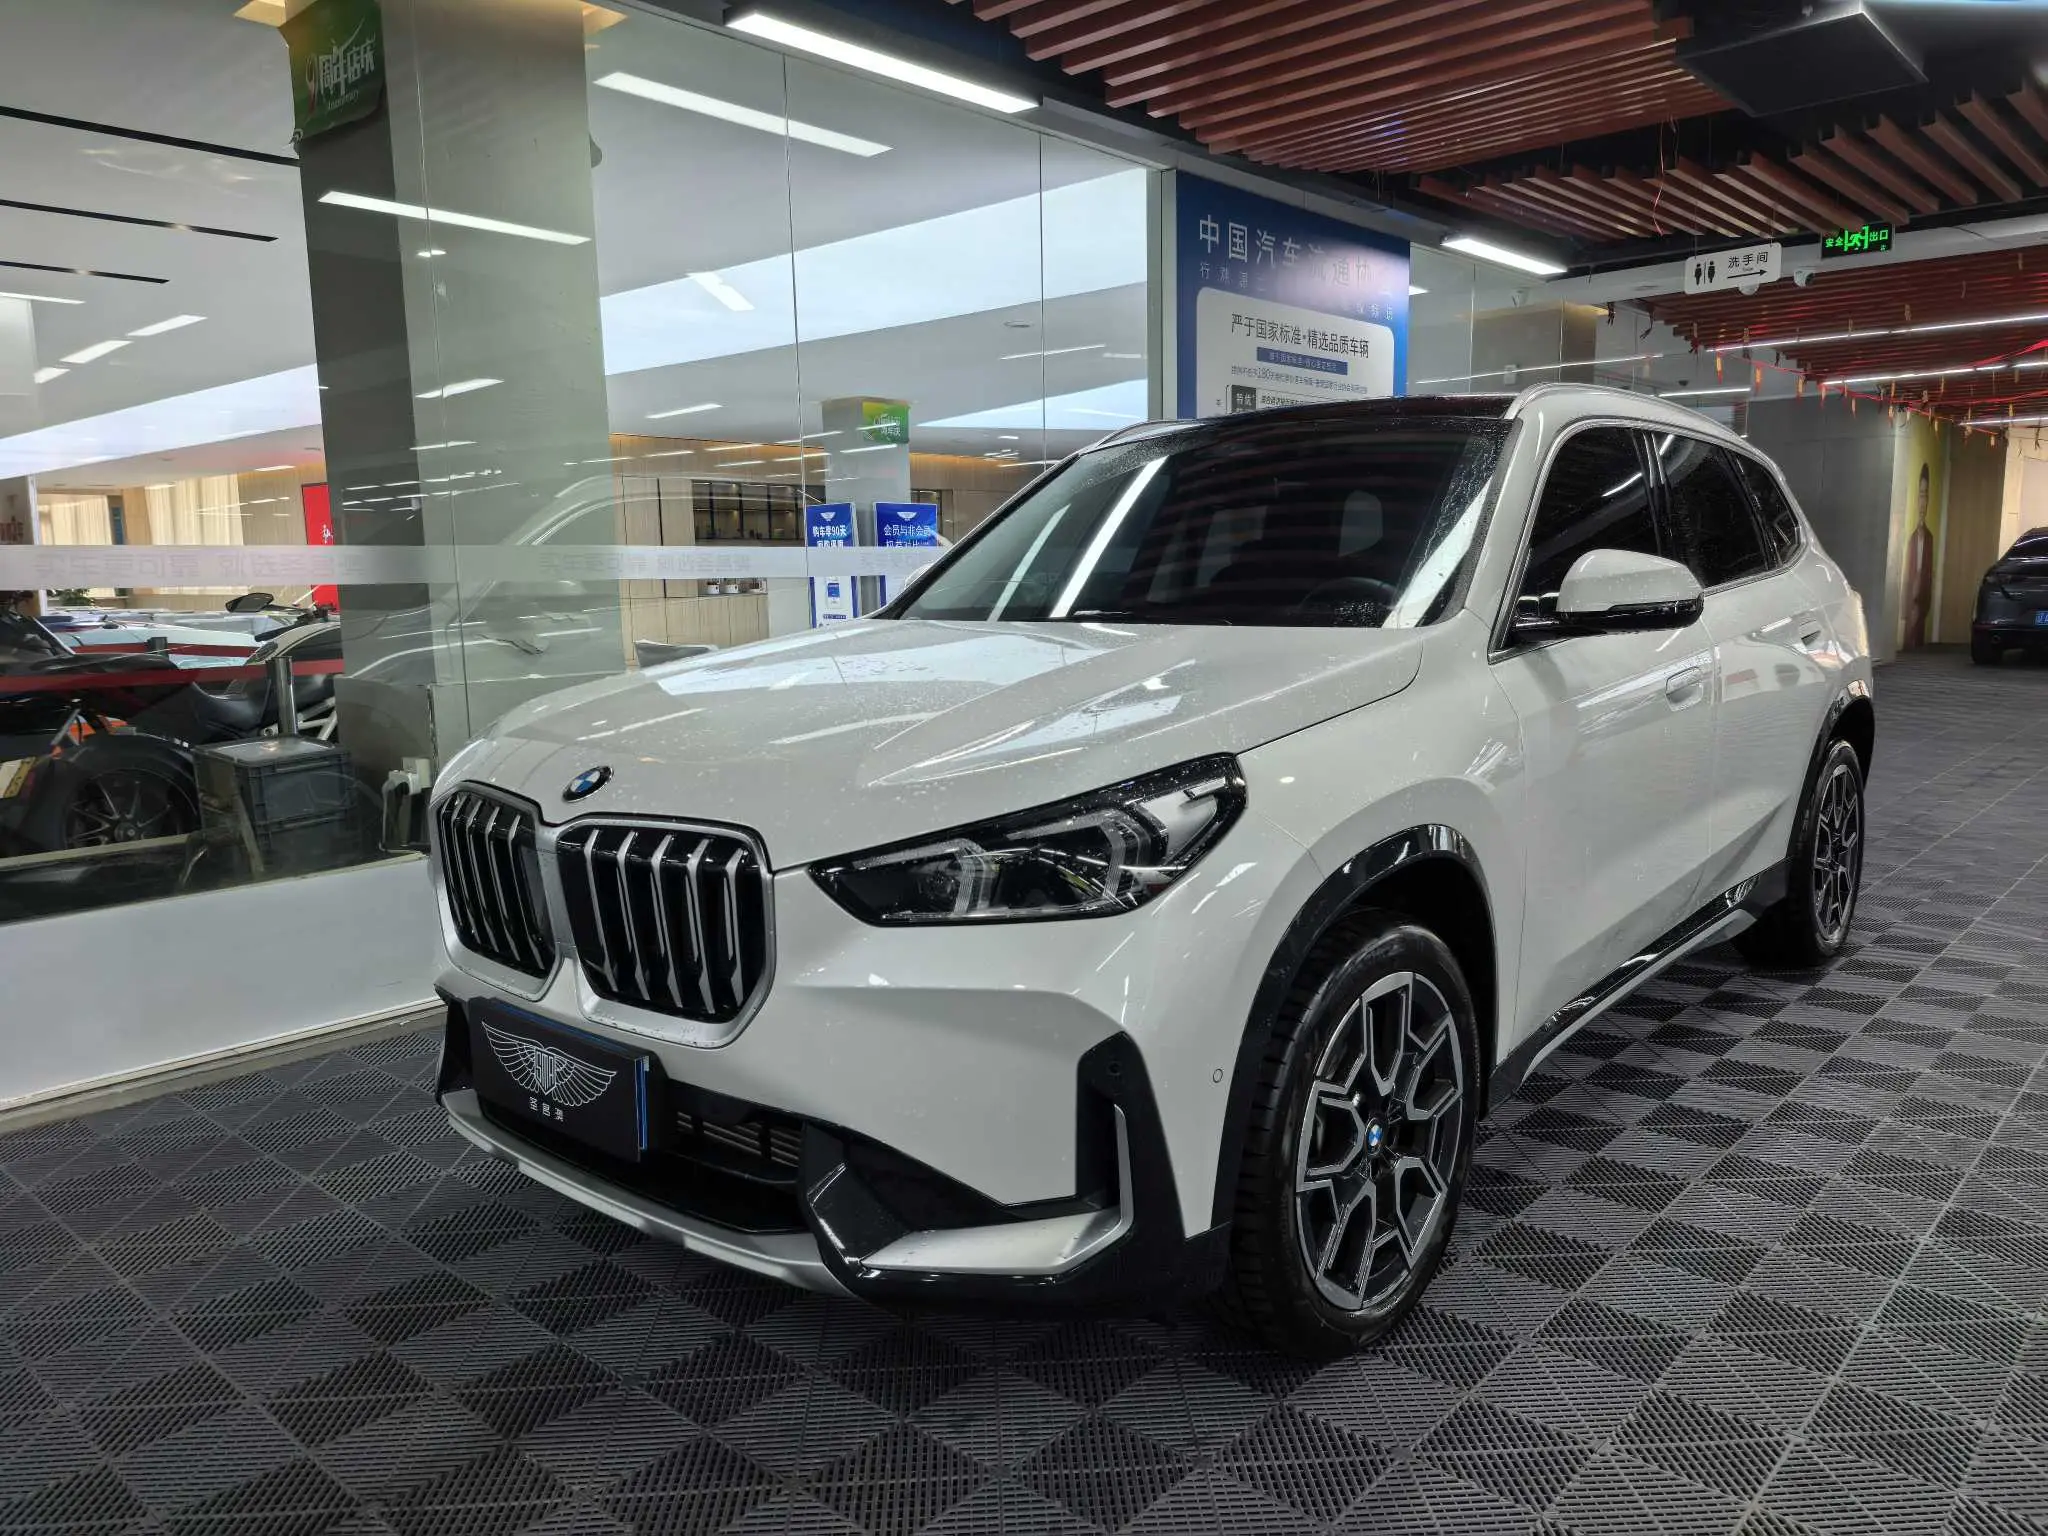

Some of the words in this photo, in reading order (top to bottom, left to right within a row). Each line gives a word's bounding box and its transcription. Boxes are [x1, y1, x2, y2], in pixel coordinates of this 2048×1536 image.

[1825, 236, 1844, 248] 安全
[1870, 229, 1889, 242] 出口
[1728, 251, 1769, 269] 洗手间
[1231, 313, 1370, 359] 严于国家标准·精选品质车辆
